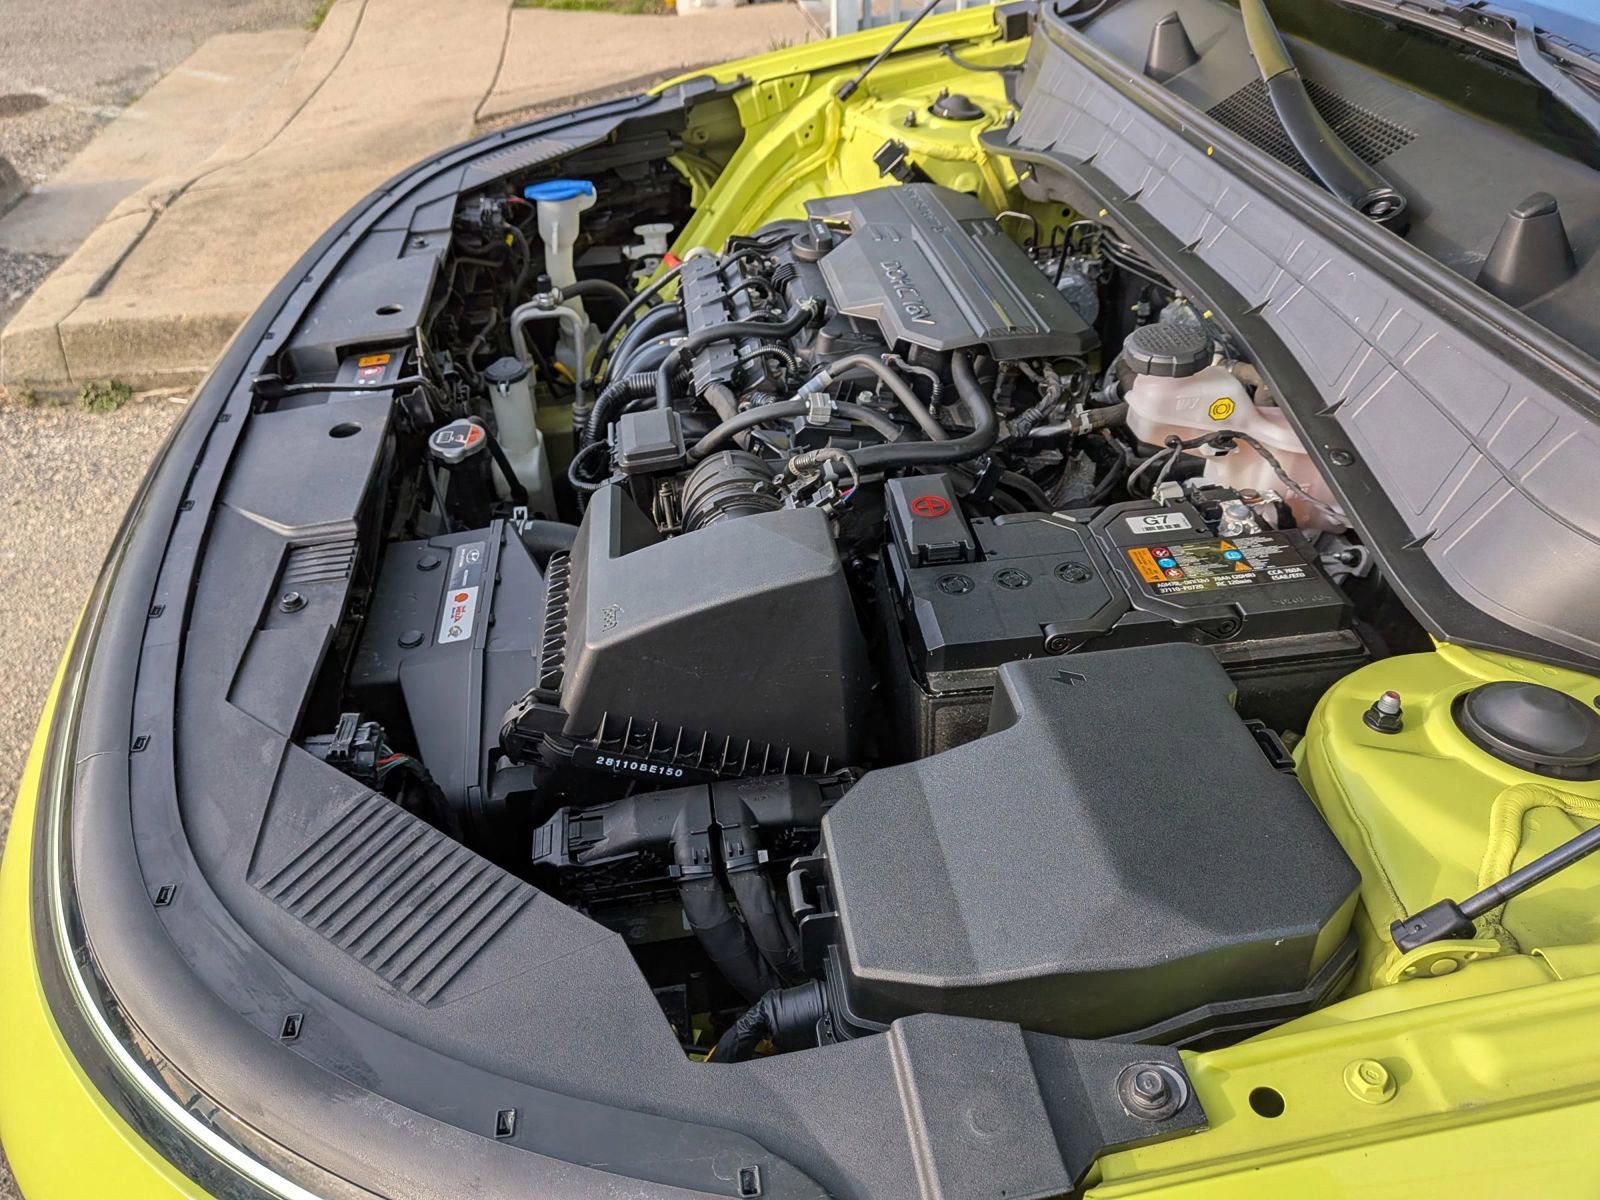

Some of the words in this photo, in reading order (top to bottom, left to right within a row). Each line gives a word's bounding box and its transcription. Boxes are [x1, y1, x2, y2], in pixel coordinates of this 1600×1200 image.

[880, 260, 921, 301] DOHC
[902, 301, 936, 325] 16V
[1143, 514, 1168, 526] G7
